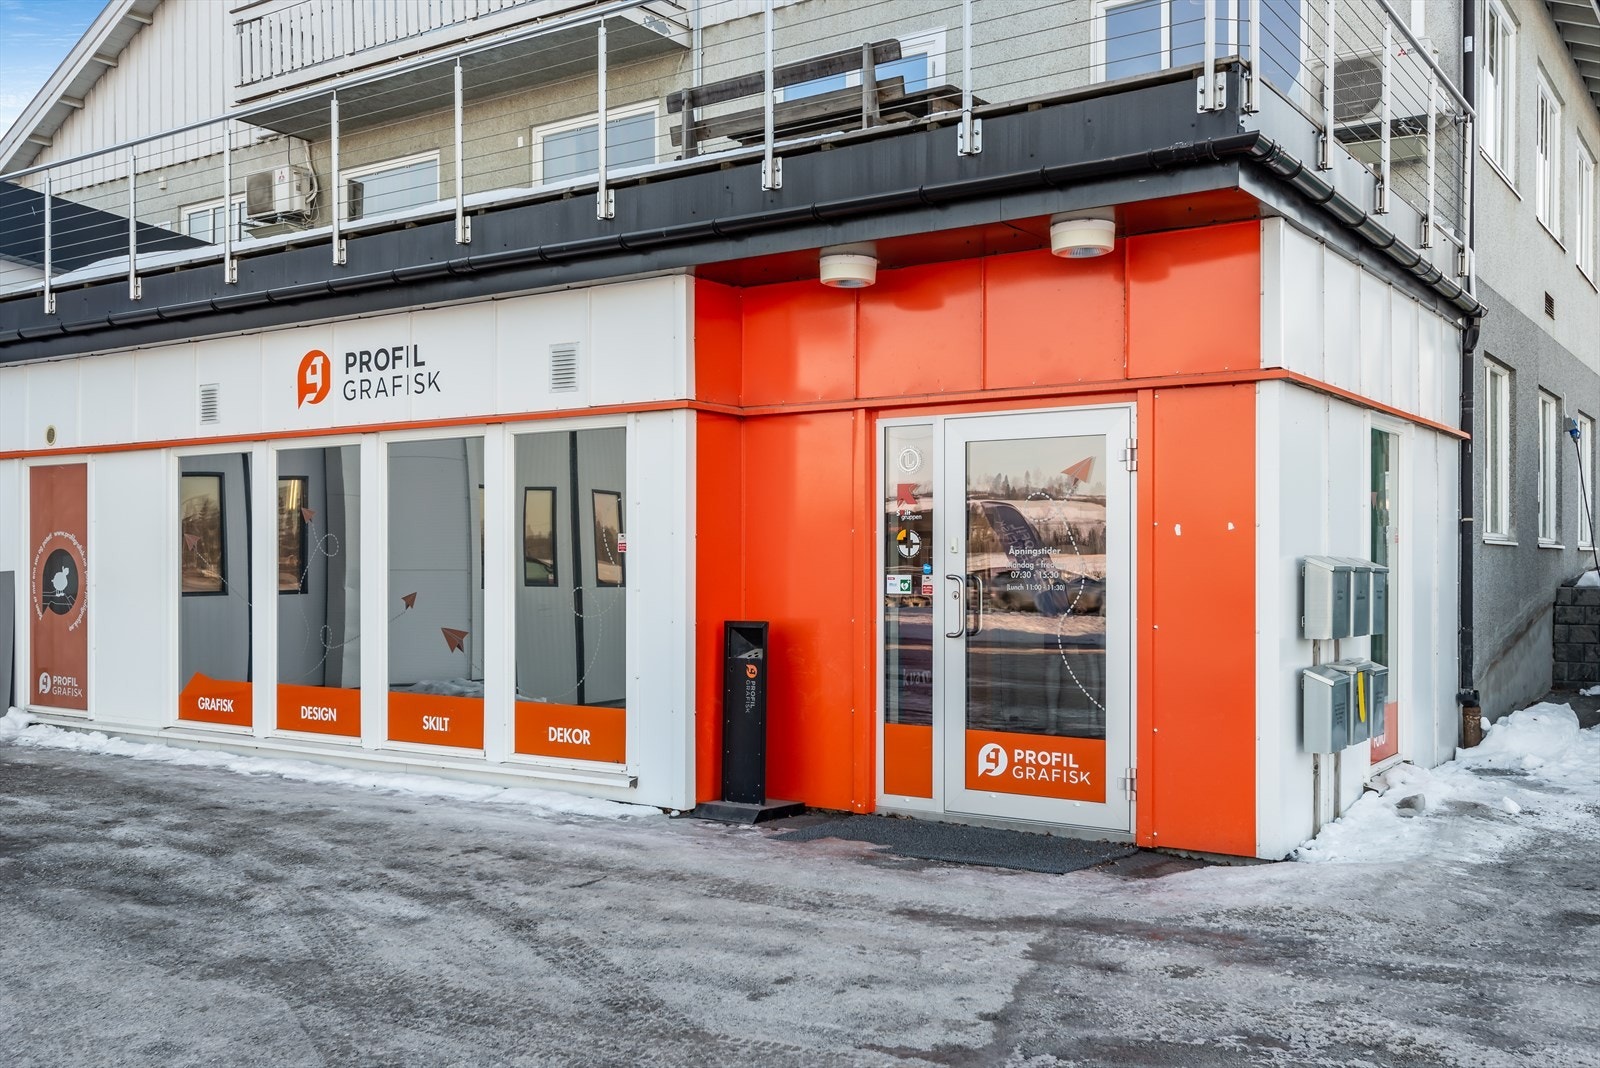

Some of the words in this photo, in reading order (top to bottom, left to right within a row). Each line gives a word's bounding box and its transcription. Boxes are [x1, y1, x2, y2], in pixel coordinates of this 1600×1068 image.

[345, 344, 426, 375] PROFIL
[343, 370, 441, 401] GRAFISK
[1009, 546, 1061, 556] Åpningstider
[52, 675, 78, 687] PROFIL
[52, 686, 83, 698] GRAFISK
[198, 697, 234, 713] GRAFISK
[301, 706, 337, 722] DESIGN
[422, 715, 450, 732] SKILT
[548, 726, 591, 745] DEKOR
[1014, 749, 1079, 768] PROFIL
[1012, 765, 1091, 785] GRAFISK
